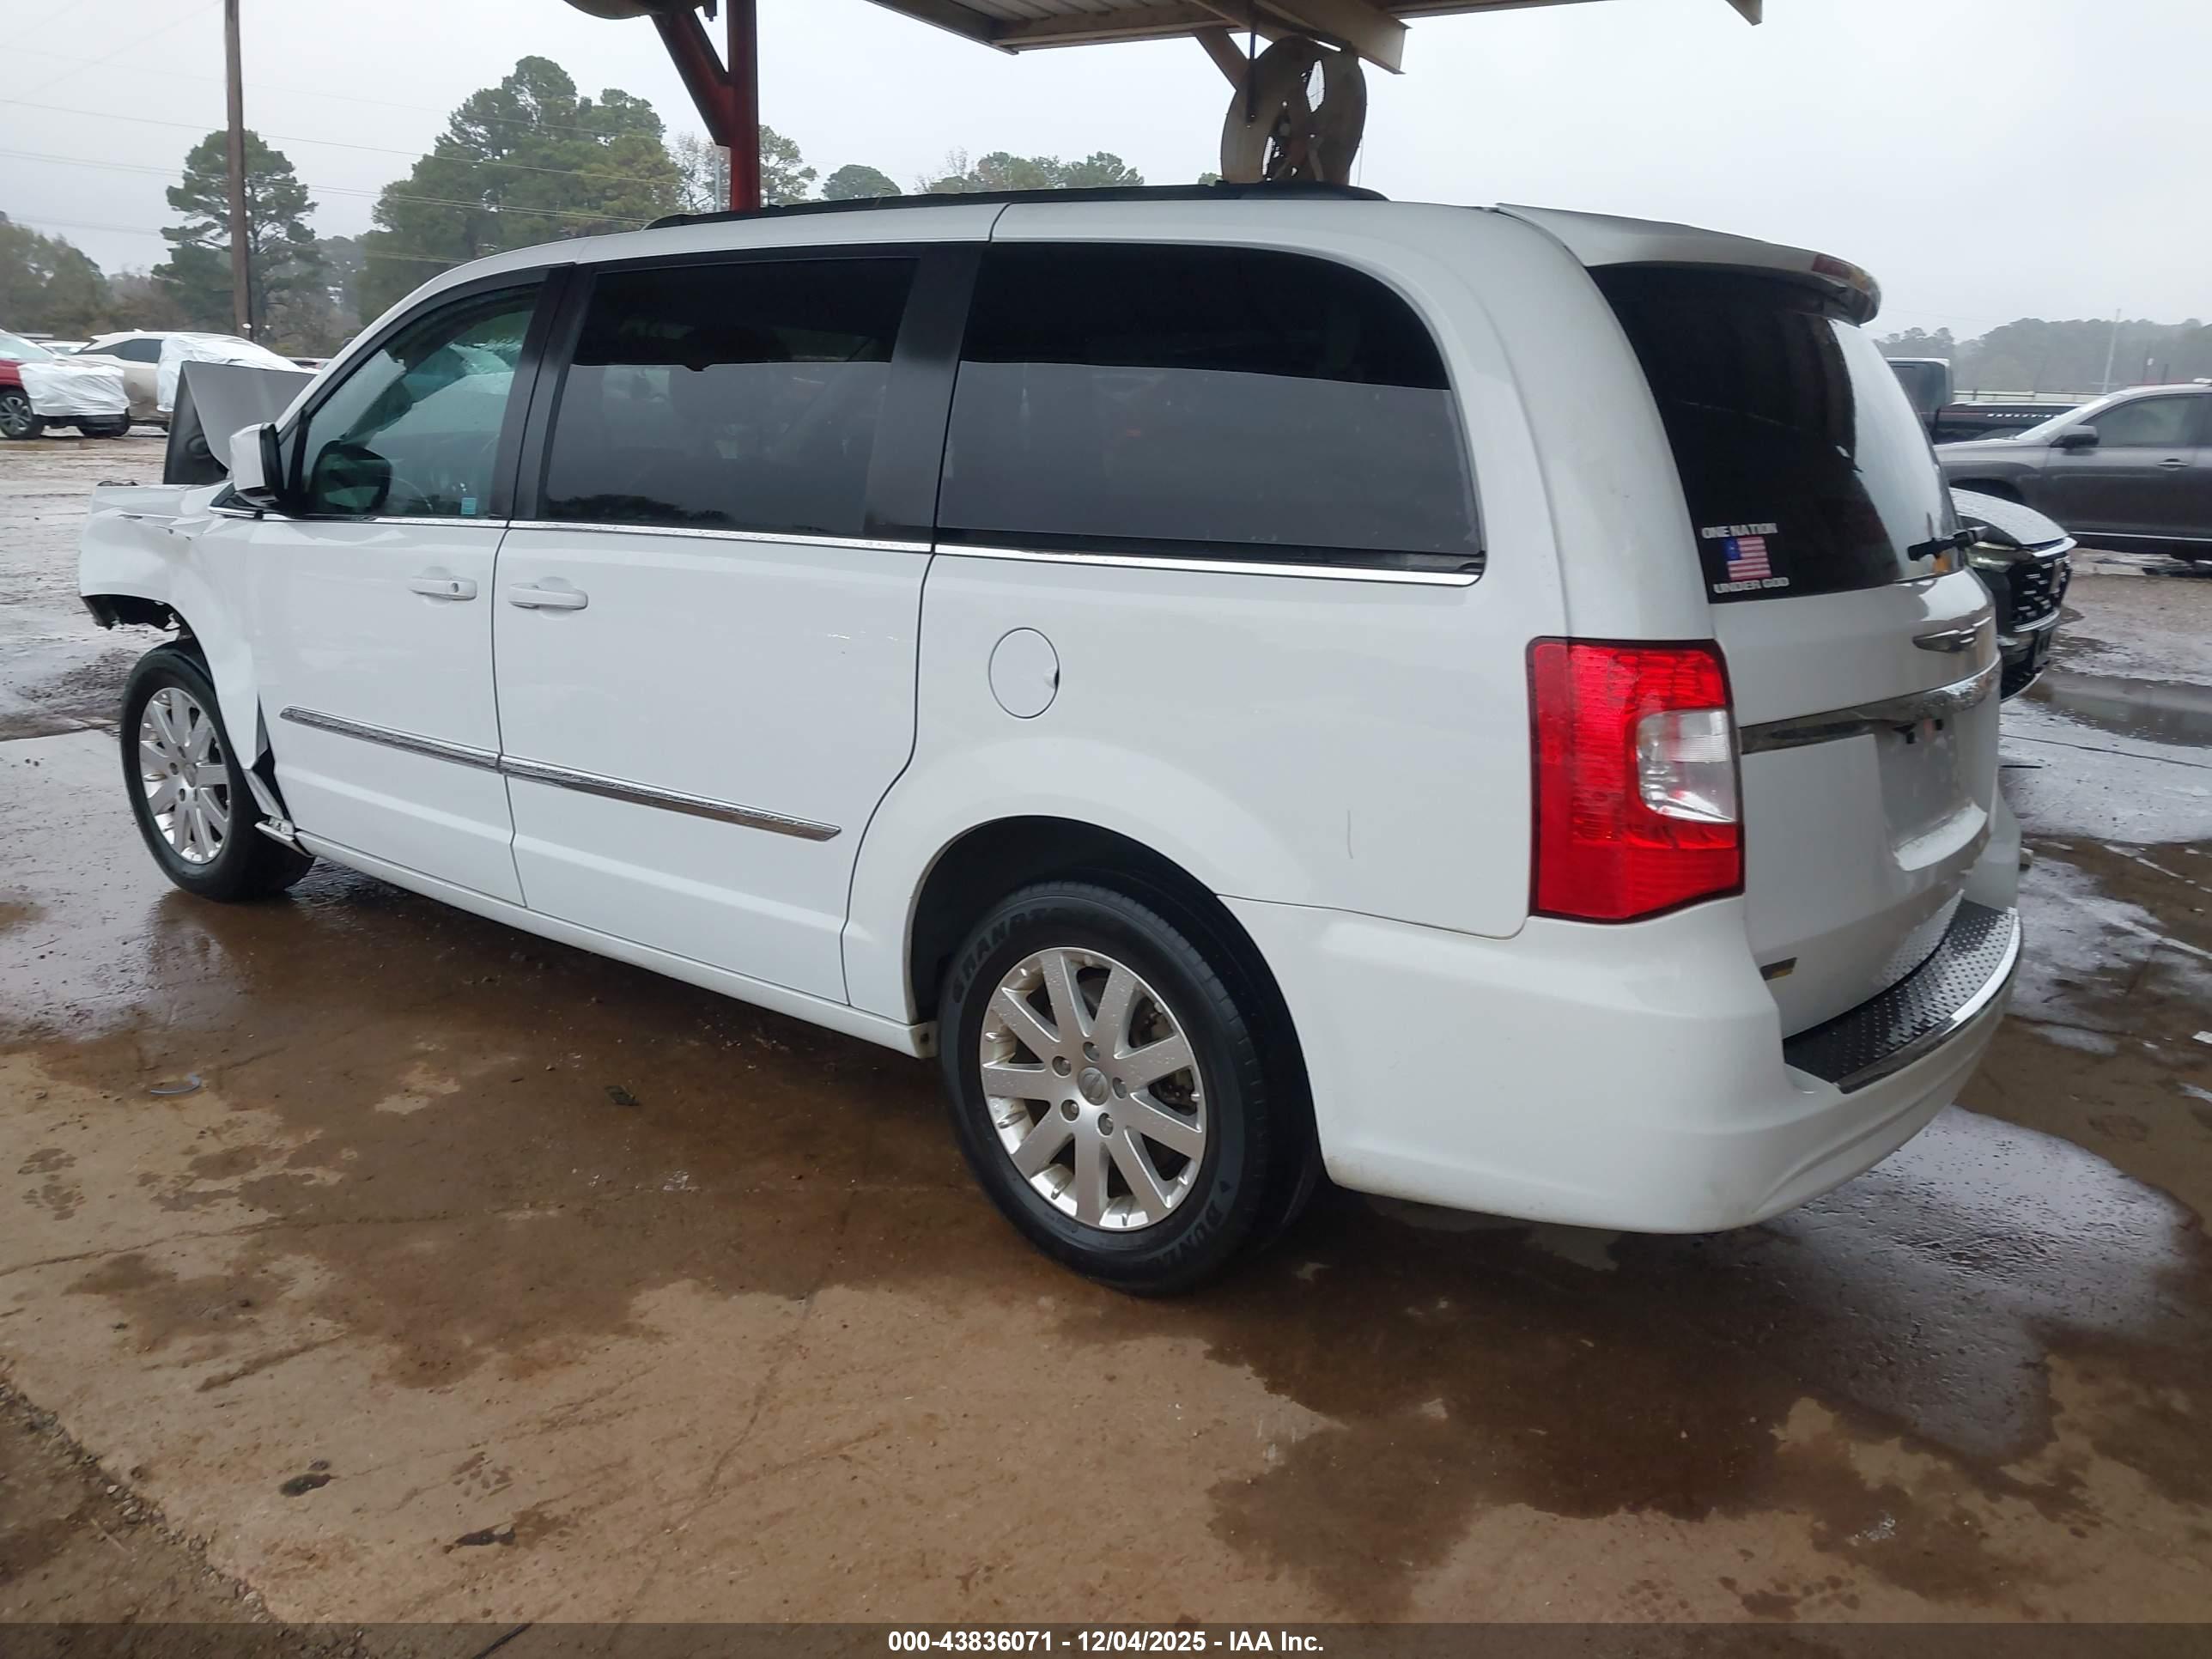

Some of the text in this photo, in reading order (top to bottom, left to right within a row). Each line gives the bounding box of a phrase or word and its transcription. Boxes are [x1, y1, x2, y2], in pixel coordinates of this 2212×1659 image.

[1702, 523, 1778, 538] ONE NATION
[1713, 577, 1790, 593] UNDER GOD
